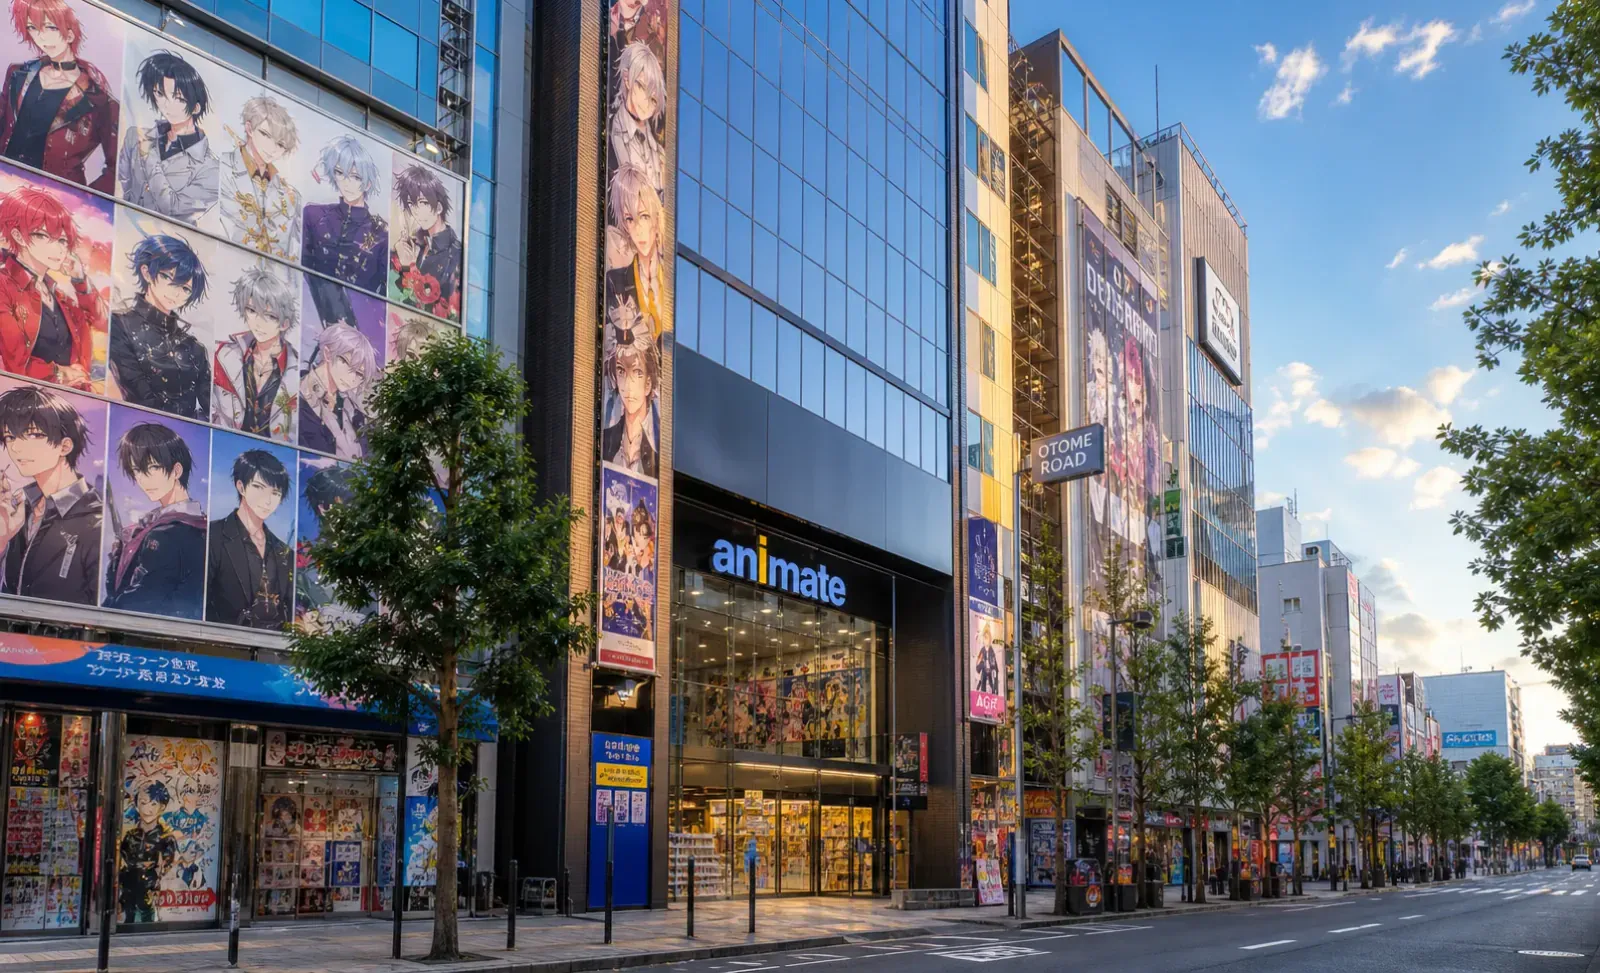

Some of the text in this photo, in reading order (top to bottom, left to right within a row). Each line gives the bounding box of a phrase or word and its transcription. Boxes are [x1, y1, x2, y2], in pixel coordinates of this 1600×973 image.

[1038, 432, 1093, 459] OTOME
[1041, 451, 1087, 475] ROAD
[712, 534, 846, 606] animate
